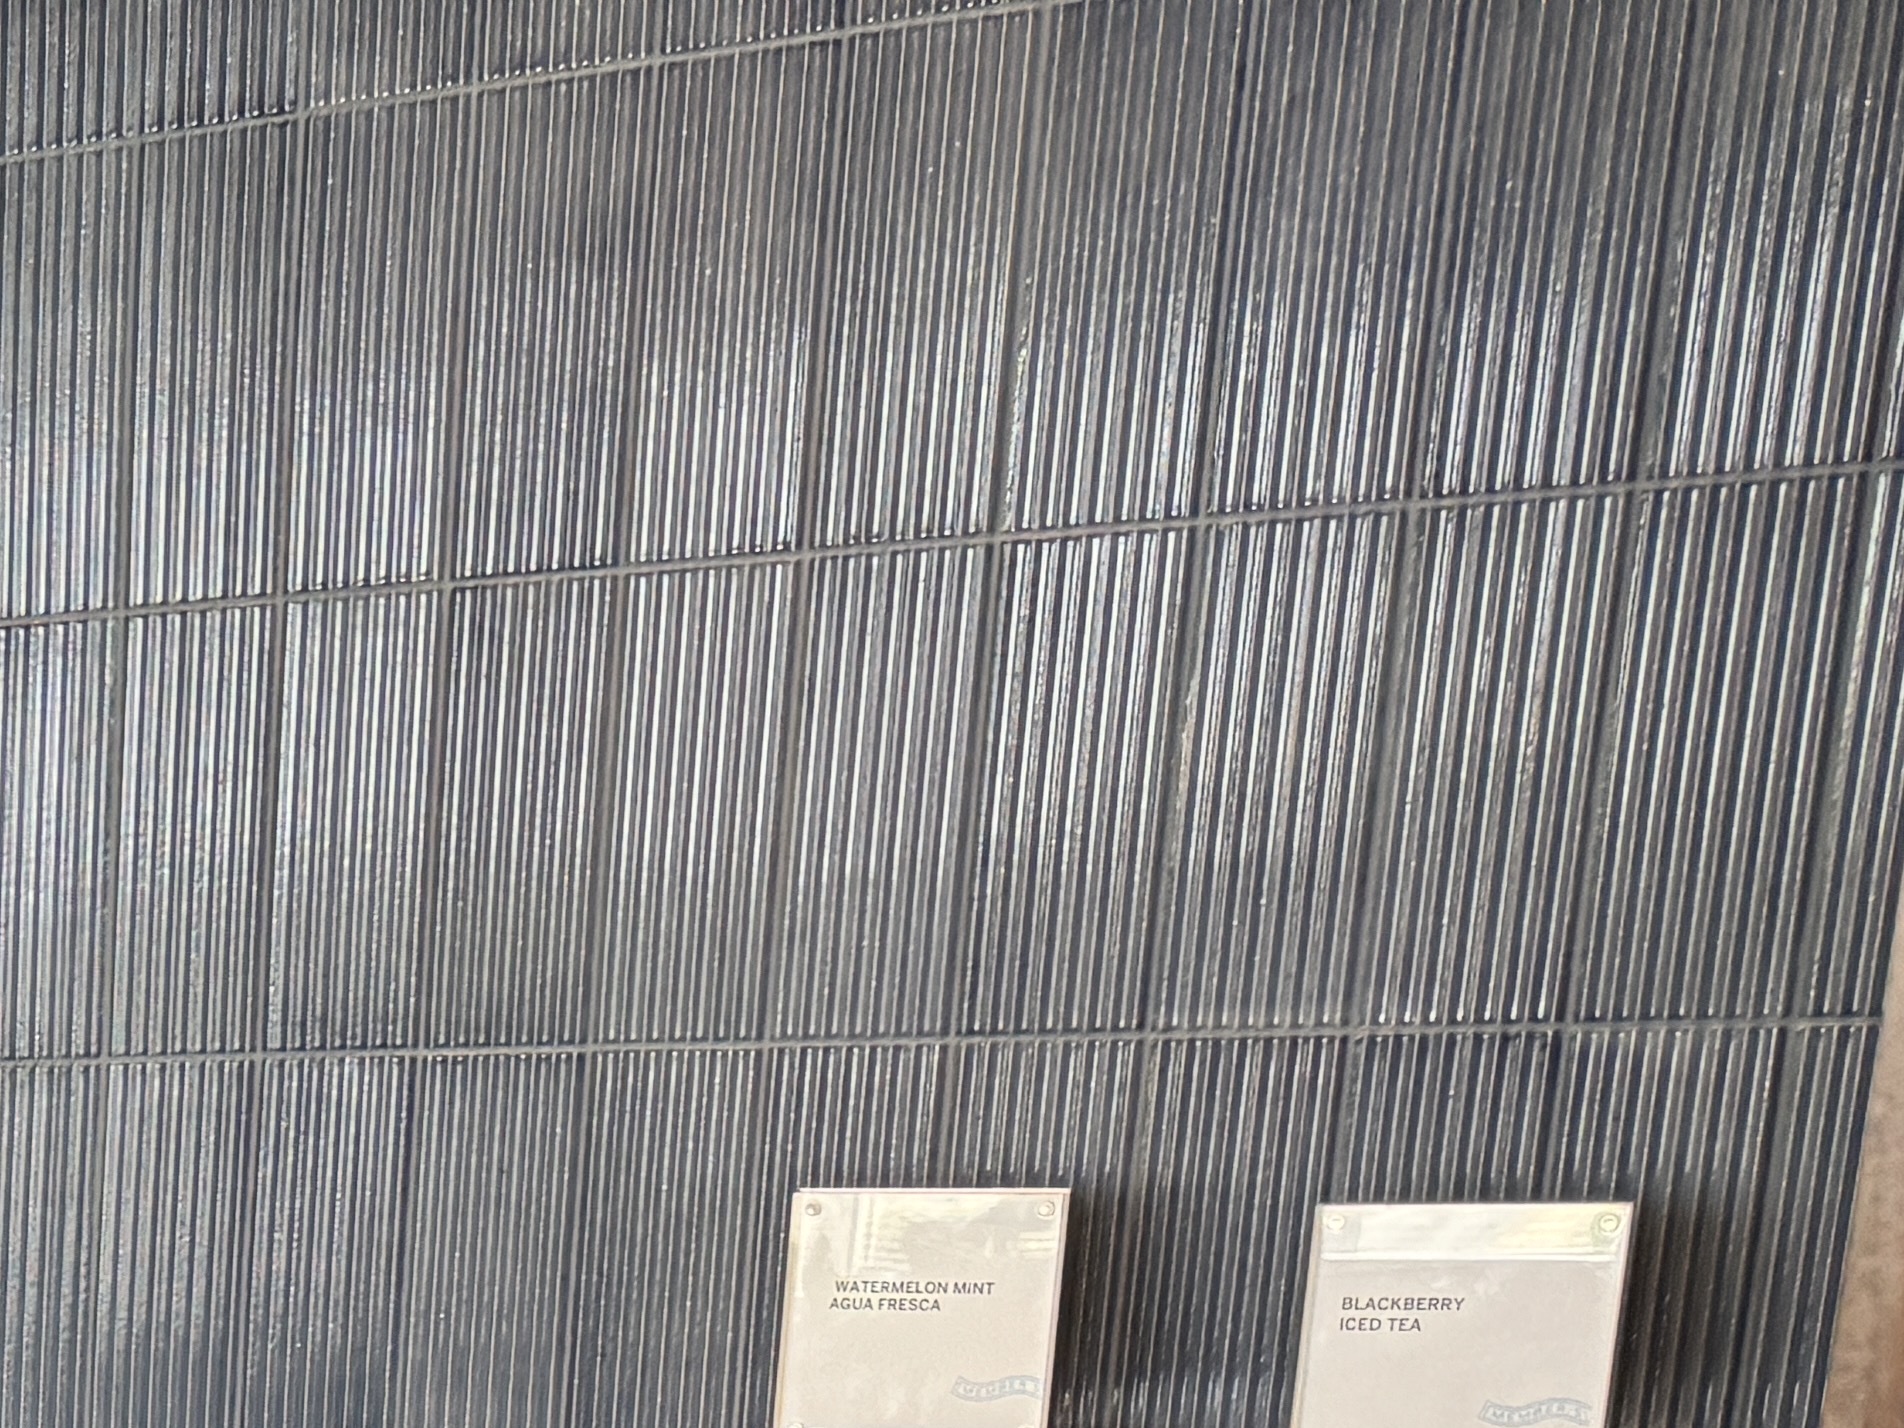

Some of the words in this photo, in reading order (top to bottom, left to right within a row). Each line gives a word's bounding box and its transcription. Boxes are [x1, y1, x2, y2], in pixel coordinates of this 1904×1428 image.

[835, 1280, 948, 1295] WATERMELON
[953, 1281, 996, 1296] MINT
[829, 1297, 874, 1311] AGUA
[878, 1298, 941, 1312] FRESCA
[1341, 1296, 1465, 1311] BLACKBERRY
[1339, 1316, 1382, 1332] ICED
[1387, 1317, 1422, 1332] TEA
